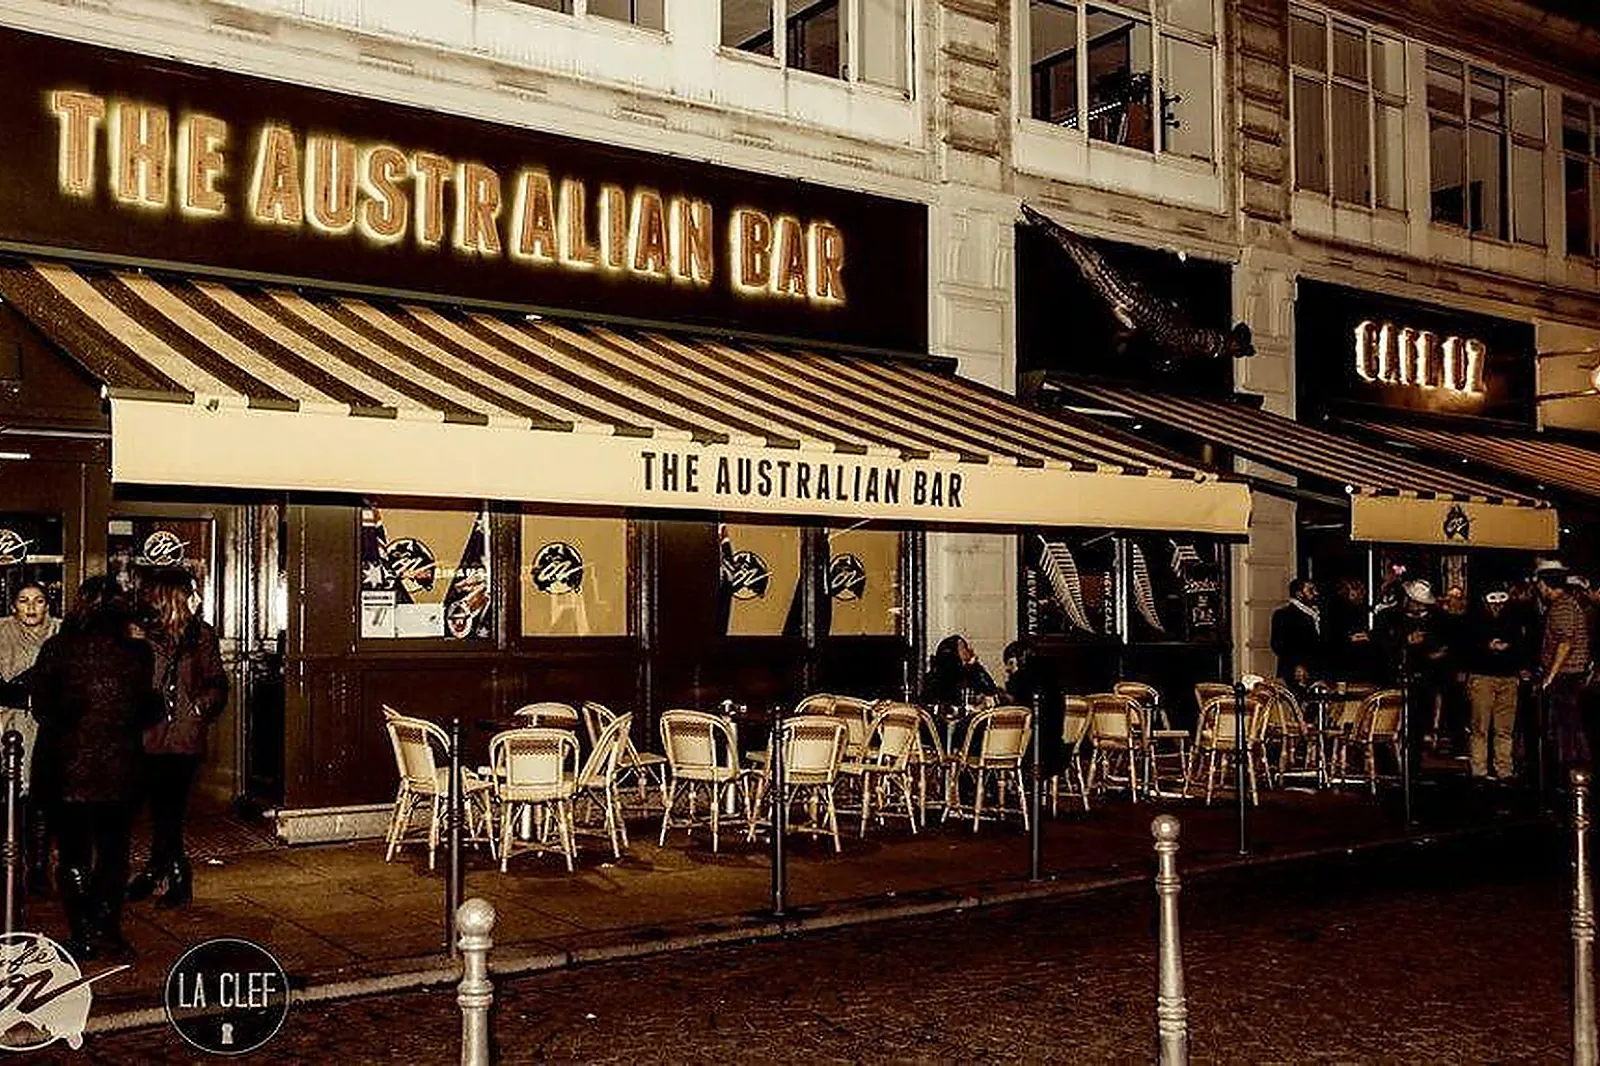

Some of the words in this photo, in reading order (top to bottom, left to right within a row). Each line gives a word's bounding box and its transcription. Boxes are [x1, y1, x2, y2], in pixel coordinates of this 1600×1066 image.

[51, 89, 228, 216] THE
[249, 122, 714, 286] AUSTRALIAN
[731, 208, 846, 304] BAR
[641, 451, 699, 493] THE
[715, 456, 901, 504] AUSTRALIAN
[913, 469, 964, 508] BAR
